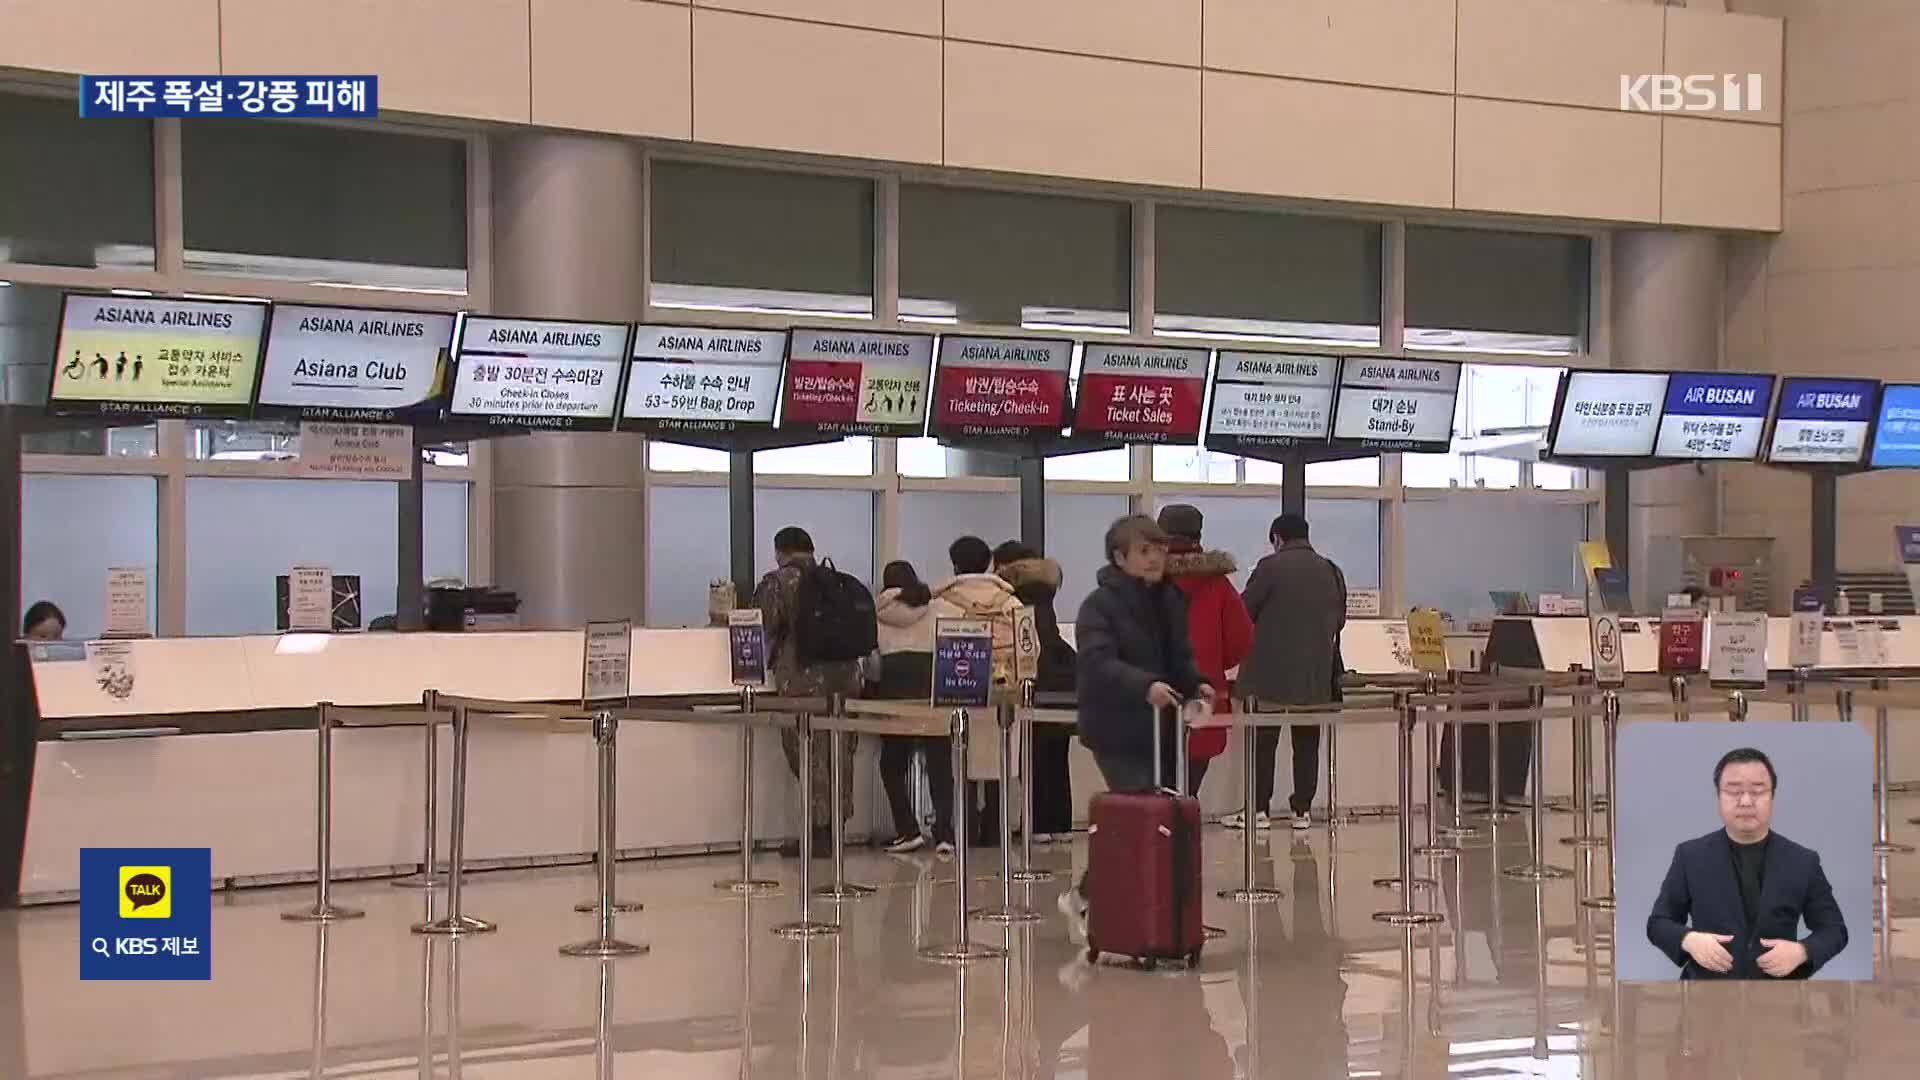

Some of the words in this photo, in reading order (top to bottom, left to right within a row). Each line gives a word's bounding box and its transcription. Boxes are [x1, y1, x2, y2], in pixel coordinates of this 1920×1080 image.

[94, 306, 157, 324] ASIANA
[161, 309, 233, 329] AIRLINES
[300, 317, 355, 334] ASIANA
[359, 320, 424, 337] AIRLINES
[488, 329, 539, 345] ASIANA
[542, 331, 601, 347] AIRLINES
[657, 336, 705, 351] ASIANA
[707, 338, 762, 354] AIRLINES
[812, 339, 856, 353] ASIANA
[858, 341, 910, 356] AIRLINES
[960, 345, 1000, 360] ASIANA
[1003, 346, 1050, 362] AIRLINES
[209, 350, 242, 364] 서비스
[1103, 353, 1141, 367] ASIANA
[1143, 356, 1188, 370] AIRLINES
[294, 361, 360, 380] Asiana
[364, 362, 407, 381] Club
[472, 363, 500, 382] 출발
[504, 366, 548, 384] 30분전
[552, 368, 604, 386] 수속마감
[1236, 360, 1273, 374] ASIANA
[1275, 362, 1318, 377] AIRLINES
[1360, 366, 1396, 380] ASIANA
[1398, 367, 1440, 382] AIRLINES
[660, 373, 696, 390] 수하물
[700, 375, 723, 391] 수속
[727, 376, 751, 392] 안내
[500, 387, 539, 398] Check-in
[540, 389, 570, 400] Closes
[1111, 384, 1126, 402] 표
[1128, 385, 1157, 404] 사는
[1158, 387, 1174, 404] 곳
[1684, 388, 1705, 404] AIR
[1705, 389, 1755, 405] BUSAN
[1796, 393, 1816, 408] AIR
[1816, 394, 1861, 409] BUSAN
[100, 402, 131, 414] STAR
[132, 404, 191, 416] ALLIANCE
[469, 397, 481, 408] 30
[484, 399, 520, 410] minutes
[522, 399, 543, 411] prior
[544, 400, 554, 410] to
[555, 400, 599, 412] departure
[700, 396, 723, 412] Bag
[726, 397, 755, 413] Drop
[949, 399, 1050, 416] Ticketing/Check-in
[1371, 397, 1393, 412] 대기
[1395, 399, 1417, 414] 손님
[1107, 406, 1140, 423] Ticket
[1142, 407, 1173, 425] Sales
[1367, 418, 1415, 435] Stand-By
[1672, 624, 1690, 636] 입구
[958, 676, 977, 688] Entry
